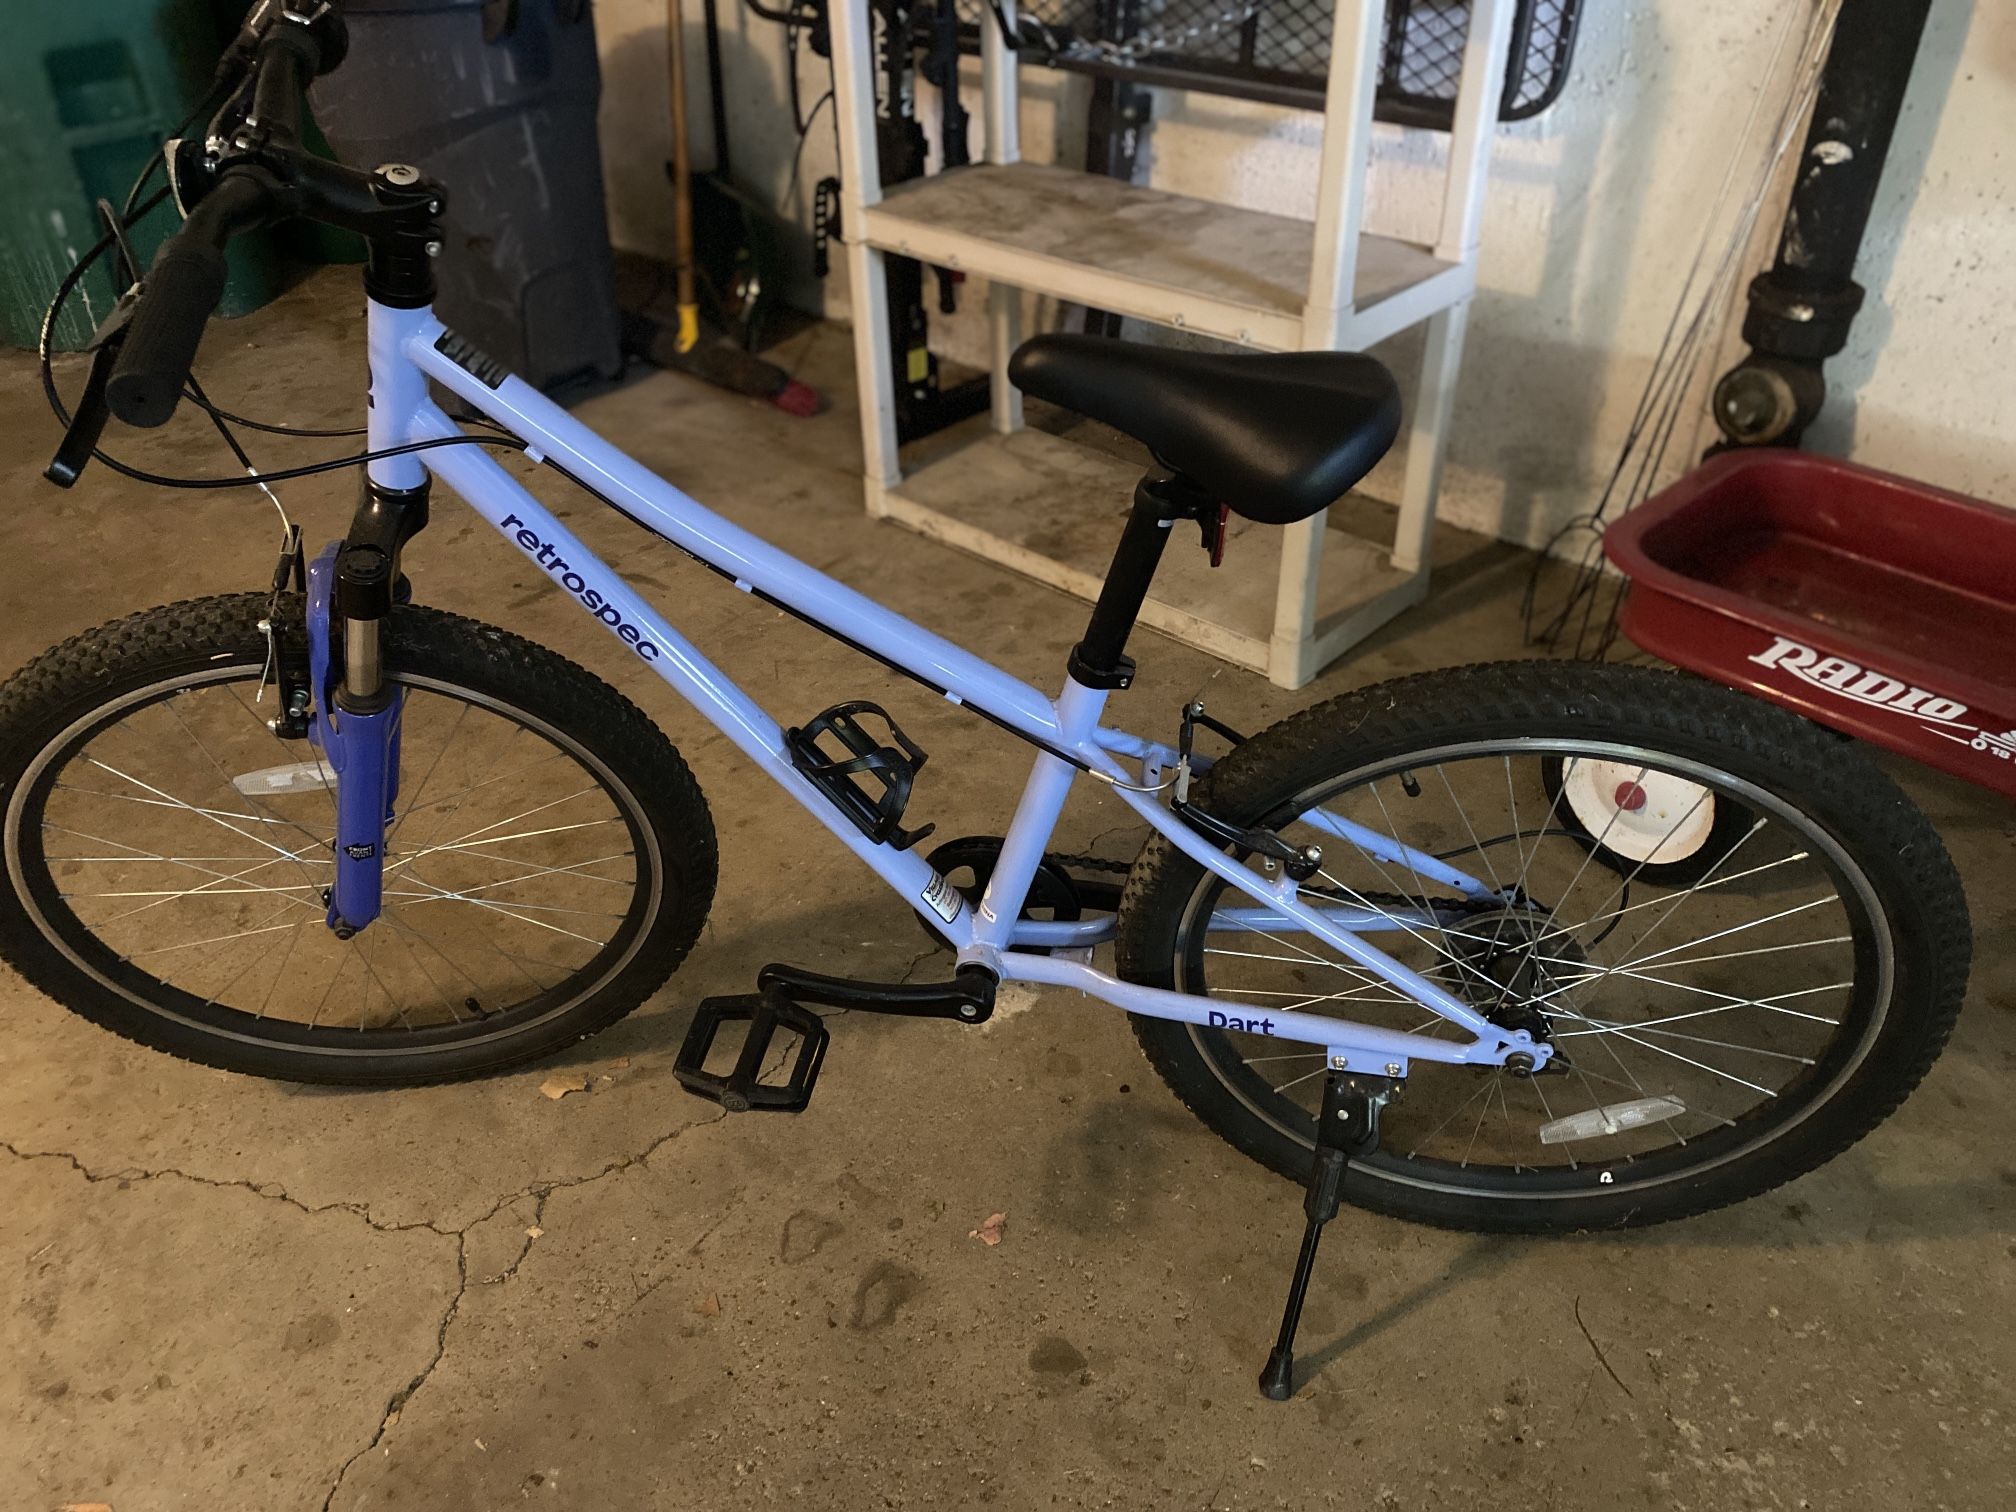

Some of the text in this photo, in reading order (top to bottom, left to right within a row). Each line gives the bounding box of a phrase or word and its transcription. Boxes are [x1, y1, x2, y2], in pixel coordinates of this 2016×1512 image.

[872, 8, 891, 119] ALLEN
[500, 513, 659, 662] retrospec
[1747, 636, 1970, 722] RADIO
[1208, 1010, 1275, 1036] Dart
